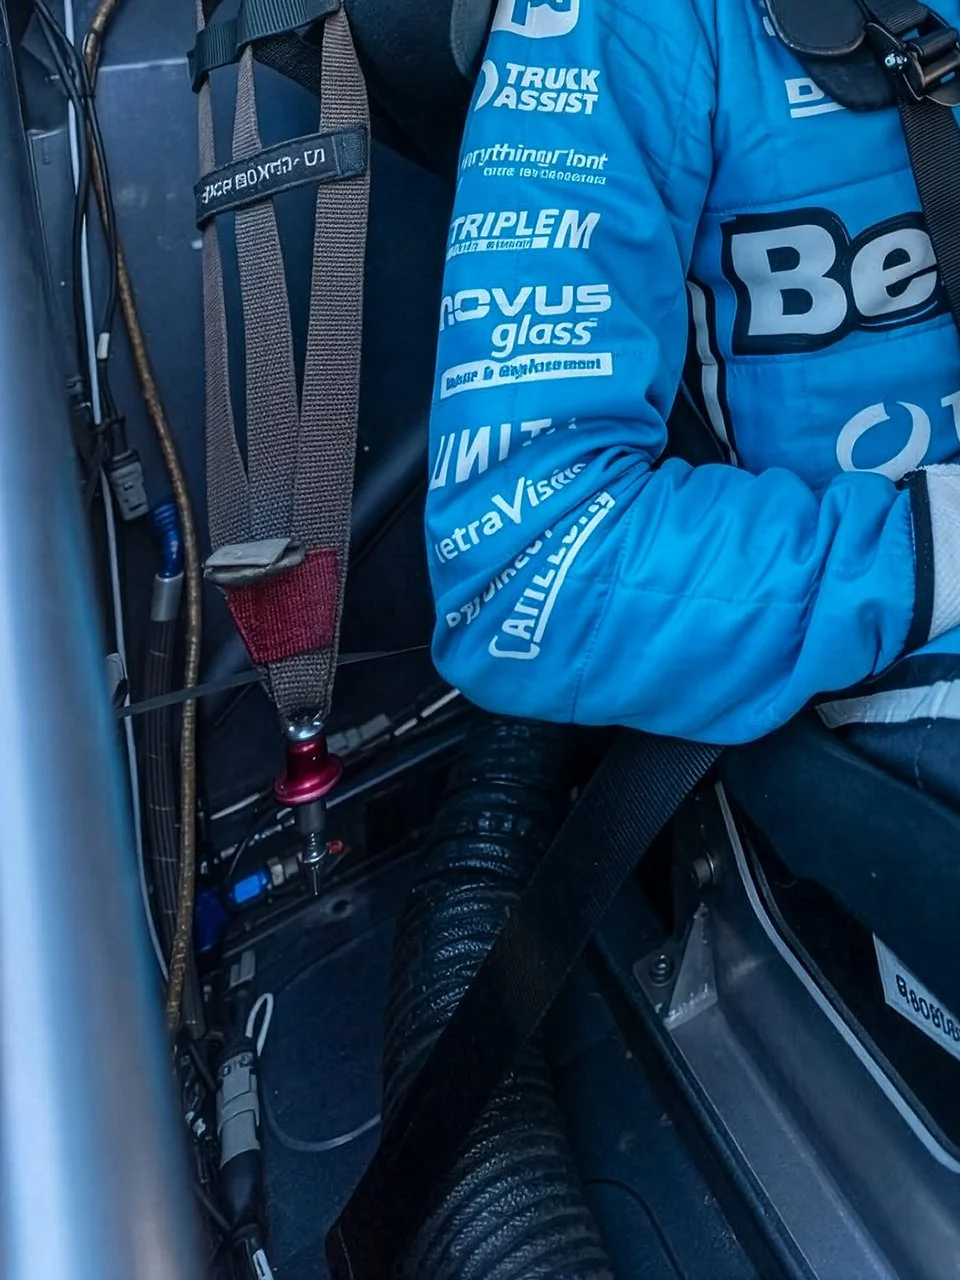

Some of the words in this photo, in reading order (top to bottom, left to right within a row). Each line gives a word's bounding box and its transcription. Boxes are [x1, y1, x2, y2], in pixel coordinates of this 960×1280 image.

[505, 62, 601, 93] TRUCK
[492, 86, 599, 115] ASSIST
[491, 314, 596, 358] glass
